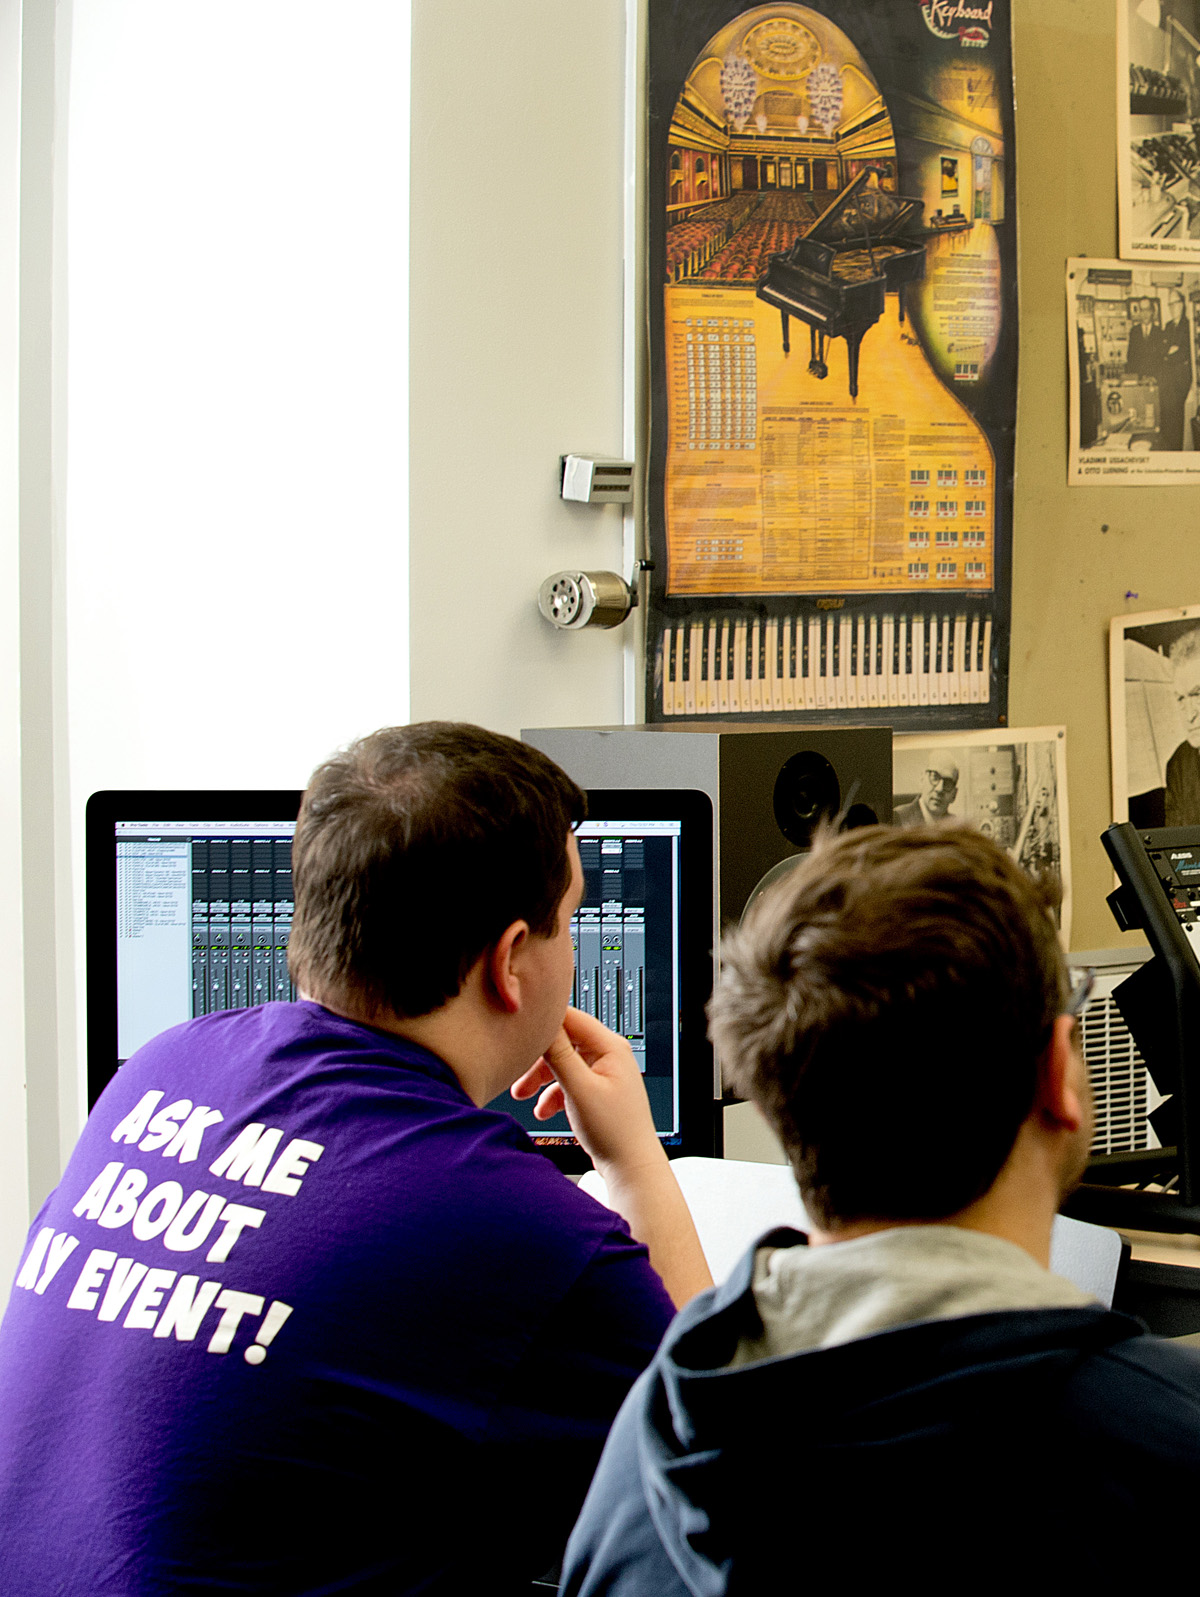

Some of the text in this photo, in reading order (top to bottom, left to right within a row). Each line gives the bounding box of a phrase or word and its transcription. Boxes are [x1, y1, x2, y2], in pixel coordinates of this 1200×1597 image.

[931, 0, 993, 29] Keyboard
[110, 1089, 325, 1197] ASK ME
[72, 1161, 267, 1264] ABOUT
[67, 1248, 294, 1365] EVENT!
